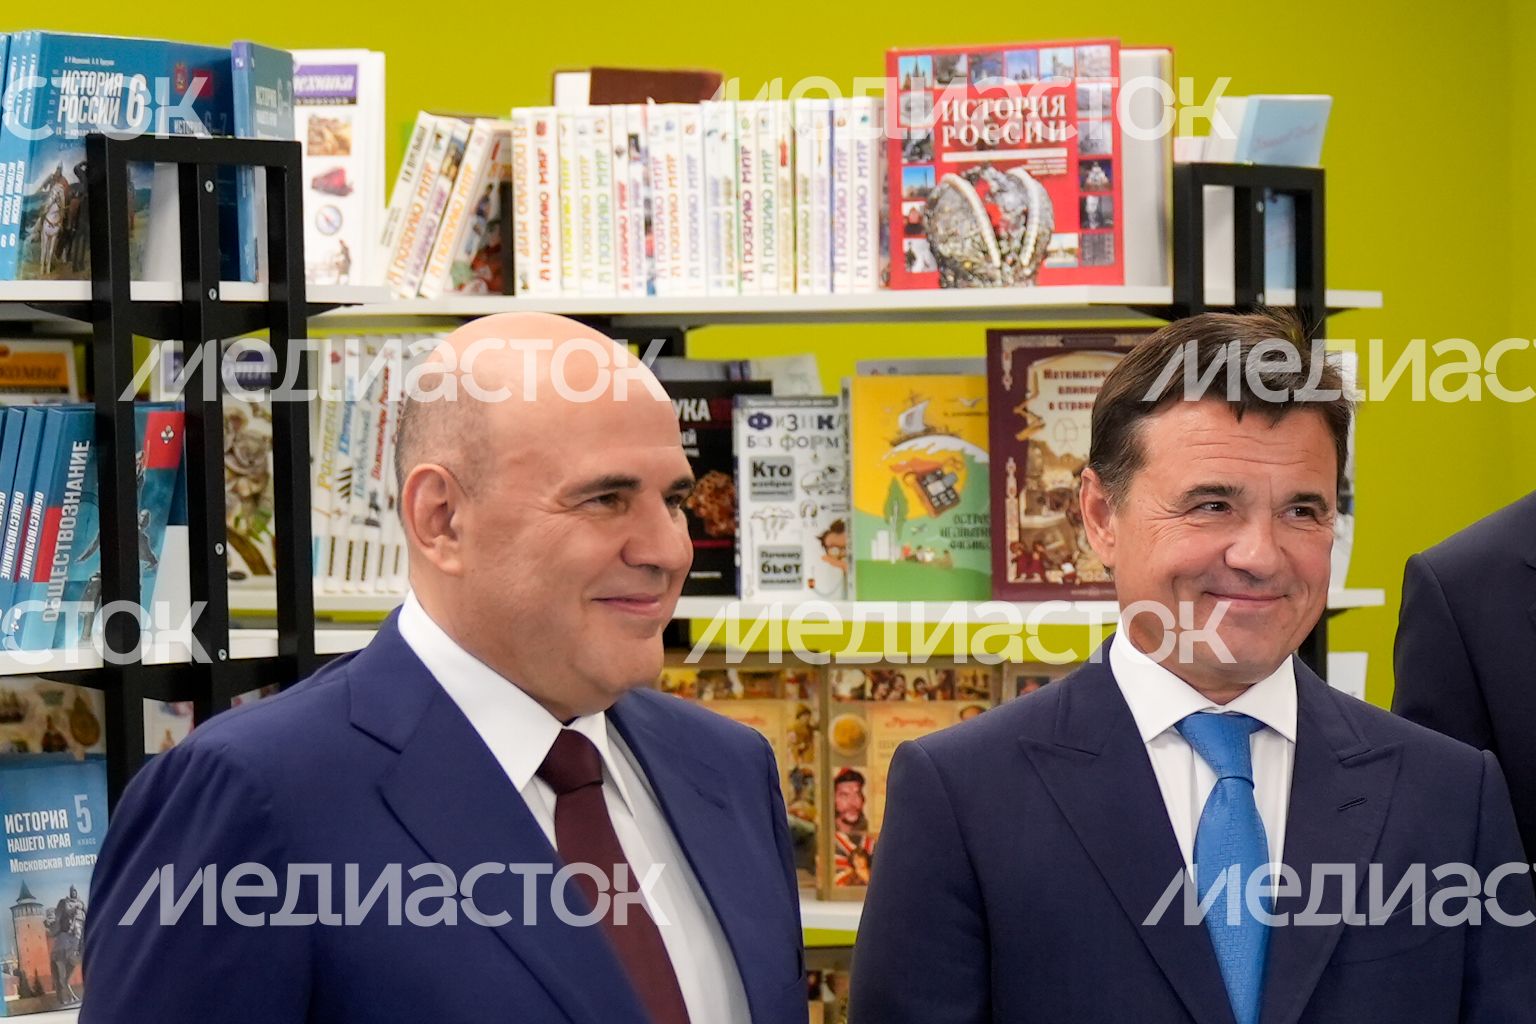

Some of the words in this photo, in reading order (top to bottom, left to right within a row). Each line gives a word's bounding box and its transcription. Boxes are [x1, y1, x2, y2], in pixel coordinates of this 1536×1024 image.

[61, 69, 123, 96] ИСТОРИЯ
[57, 95, 121, 125] РОССИИ
[126, 74, 147, 127] 6
[941, 95, 1066, 122] ИСТОРИЯ
[941, 120, 1067, 147] РОССИИ
[752, 460, 792, 478] Кто
[20, 491, 44, 580] ОБЩЕСТВОЗНАНИЕ
[42, 440, 91, 624] ОБЩЕСТВОЗНАНИЕ
[4, 809, 69, 834] ИСТОРИЯ
[74, 794, 92, 834] 5
[7, 836, 45, 853] НАШЕГО
[46, 833, 71, 849] КРАЯ
[10, 857, 63, 873] Московская
